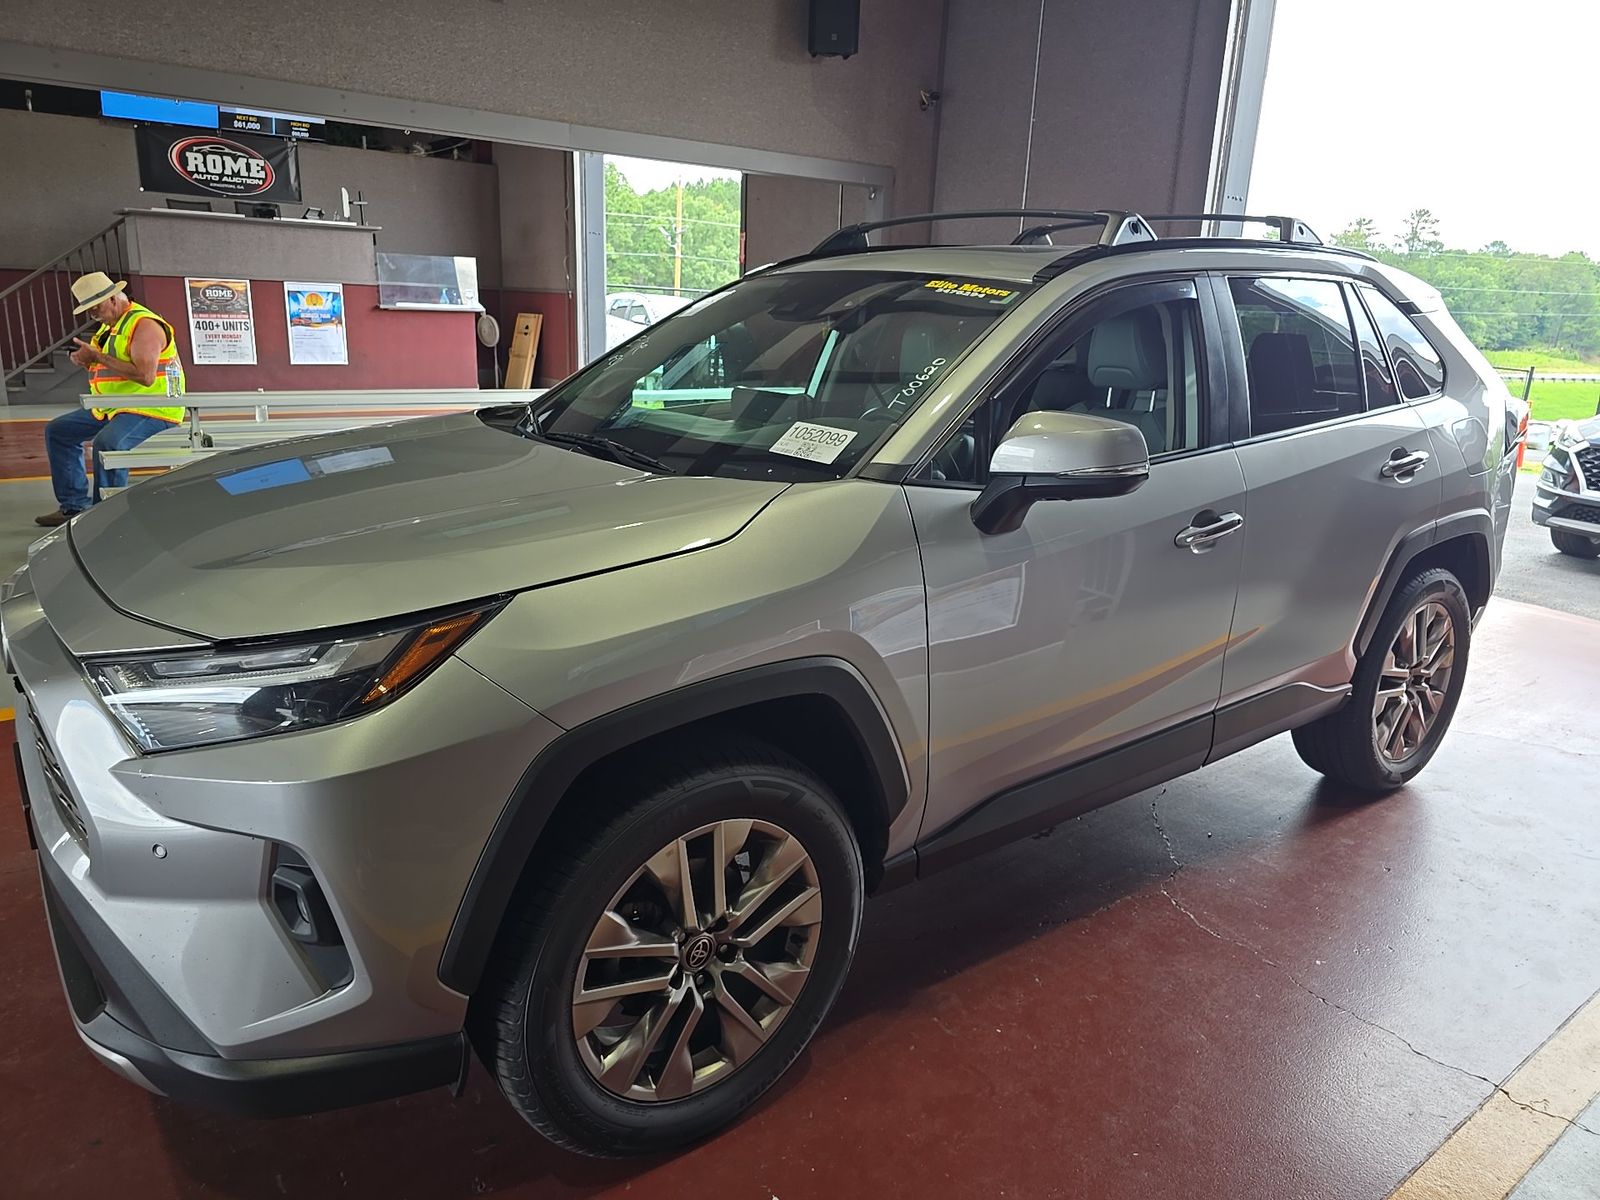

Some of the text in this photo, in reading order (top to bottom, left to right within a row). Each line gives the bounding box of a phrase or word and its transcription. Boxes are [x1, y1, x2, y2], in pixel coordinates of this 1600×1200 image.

[233, 120, 260, 130] $61,000
[185, 151, 266, 179] ROME
[192, 173, 263, 185] AUTO AUCTION
[205, 289, 233, 298] ROME
[924, 280, 958, 289] Elite
[958, 283, 1012, 297] Motors
[195, 320, 250, 331] 400+ UNITS
[789, 425, 848, 447] 1052099
